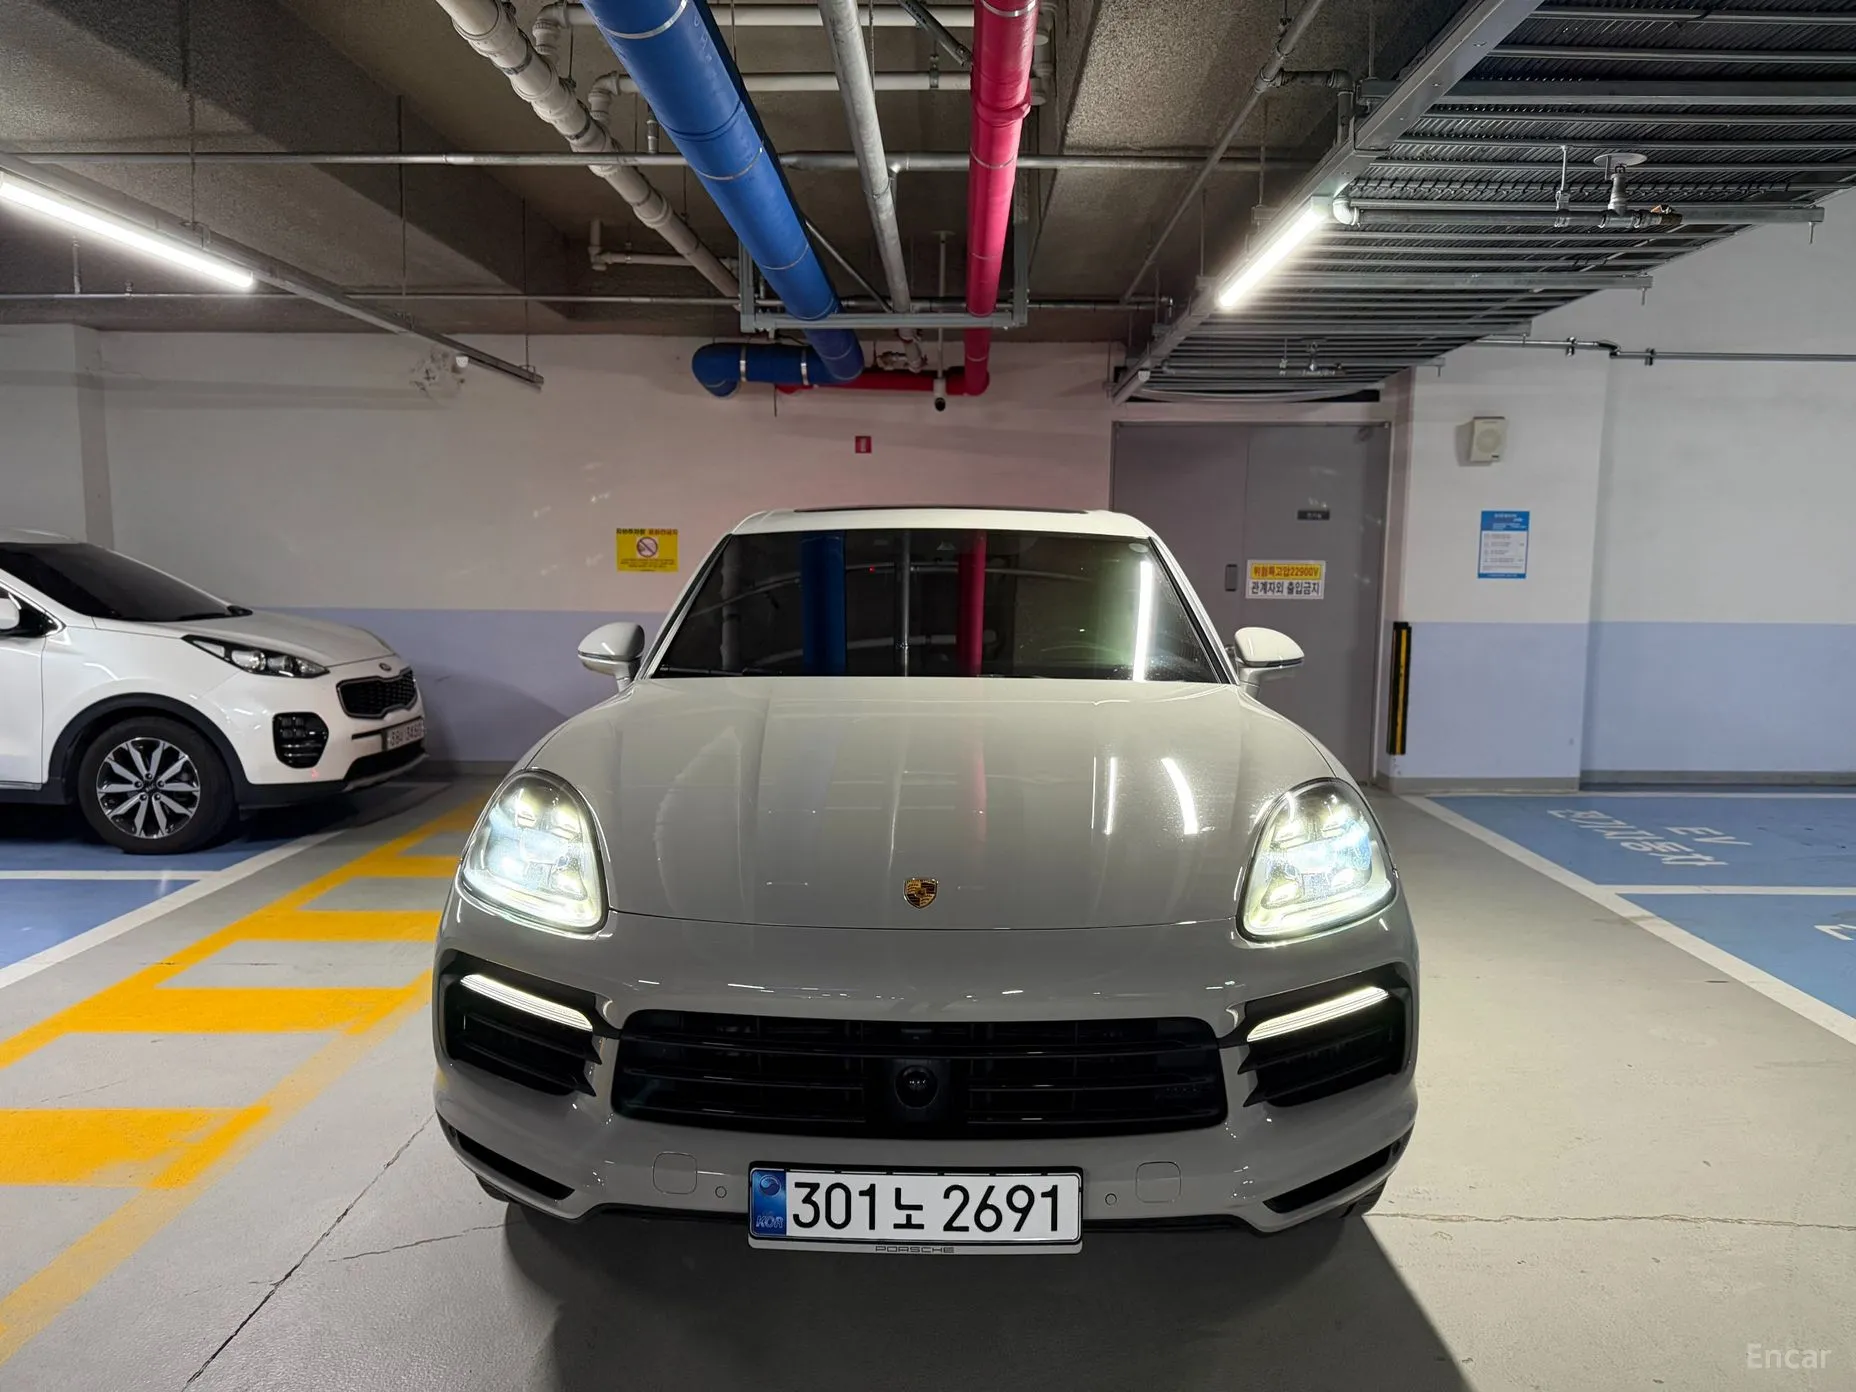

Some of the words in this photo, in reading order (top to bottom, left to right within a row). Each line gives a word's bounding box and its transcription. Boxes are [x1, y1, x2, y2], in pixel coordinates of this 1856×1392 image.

[1251, 581, 1284, 595] 관계자외
[1287, 581, 1320, 595] 출입금지
[1546, 808, 1729, 866] 전기자동차
[1664, 826, 1752, 846] EV
[792, 1181, 925, 1231] 301노
[942, 1183, 1059, 1233] 2691
[755, 1215, 784, 1229] KOR
[875, 1245, 955, 1254] PORSCHE
